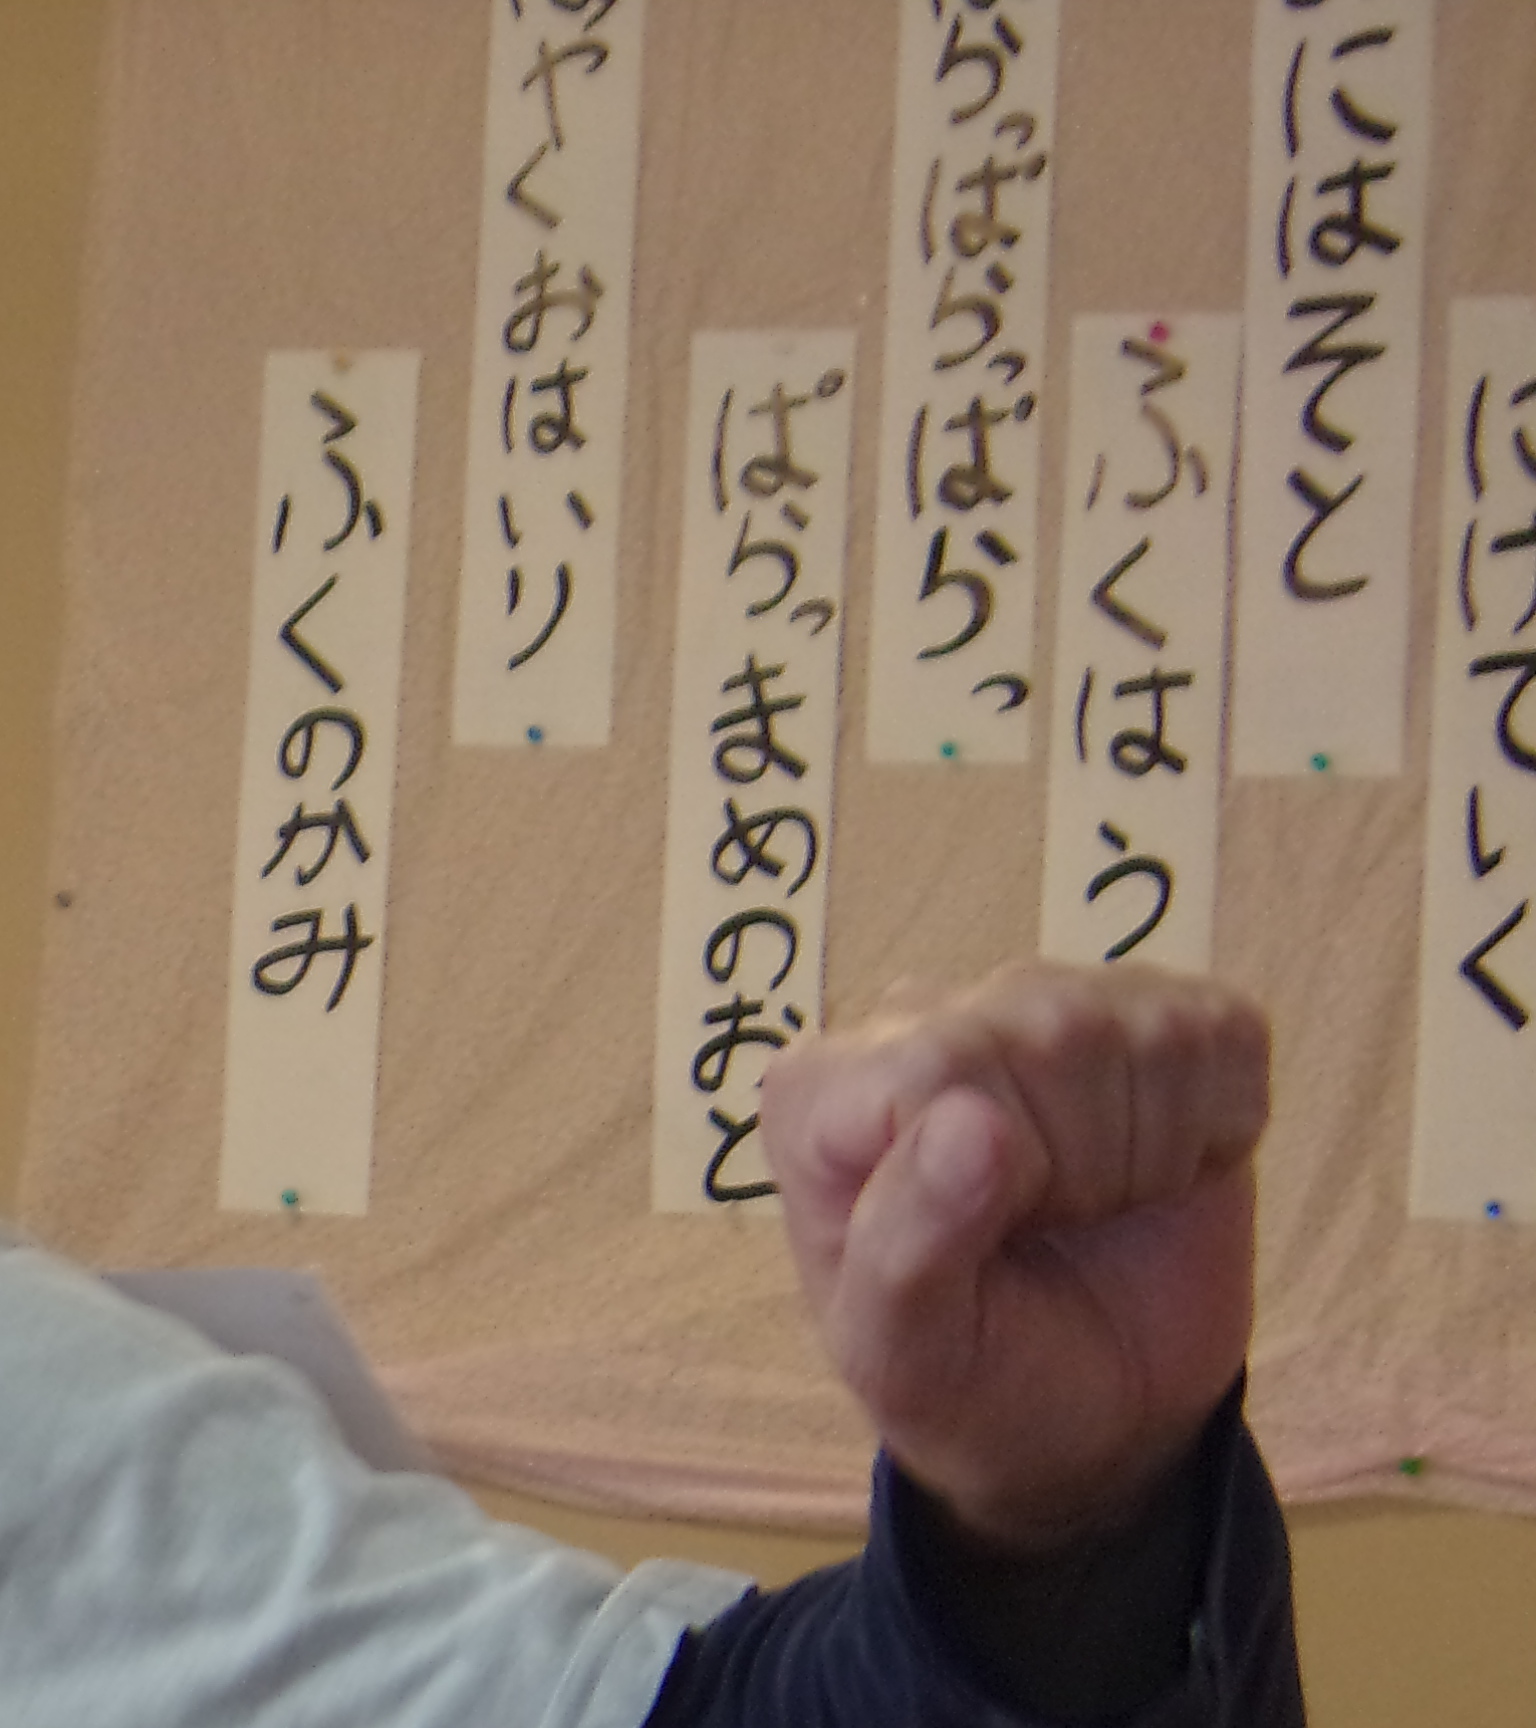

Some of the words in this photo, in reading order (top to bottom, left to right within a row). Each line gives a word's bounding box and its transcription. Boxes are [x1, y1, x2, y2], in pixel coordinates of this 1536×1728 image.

[500, 0, 618, 671] やくおはいり
[906, 0, 1047, 713] らっぱらっぱらっ
[1276, 0, 1403, 602] にはそと
[249, 390, 386, 1013] ふくのかみ
